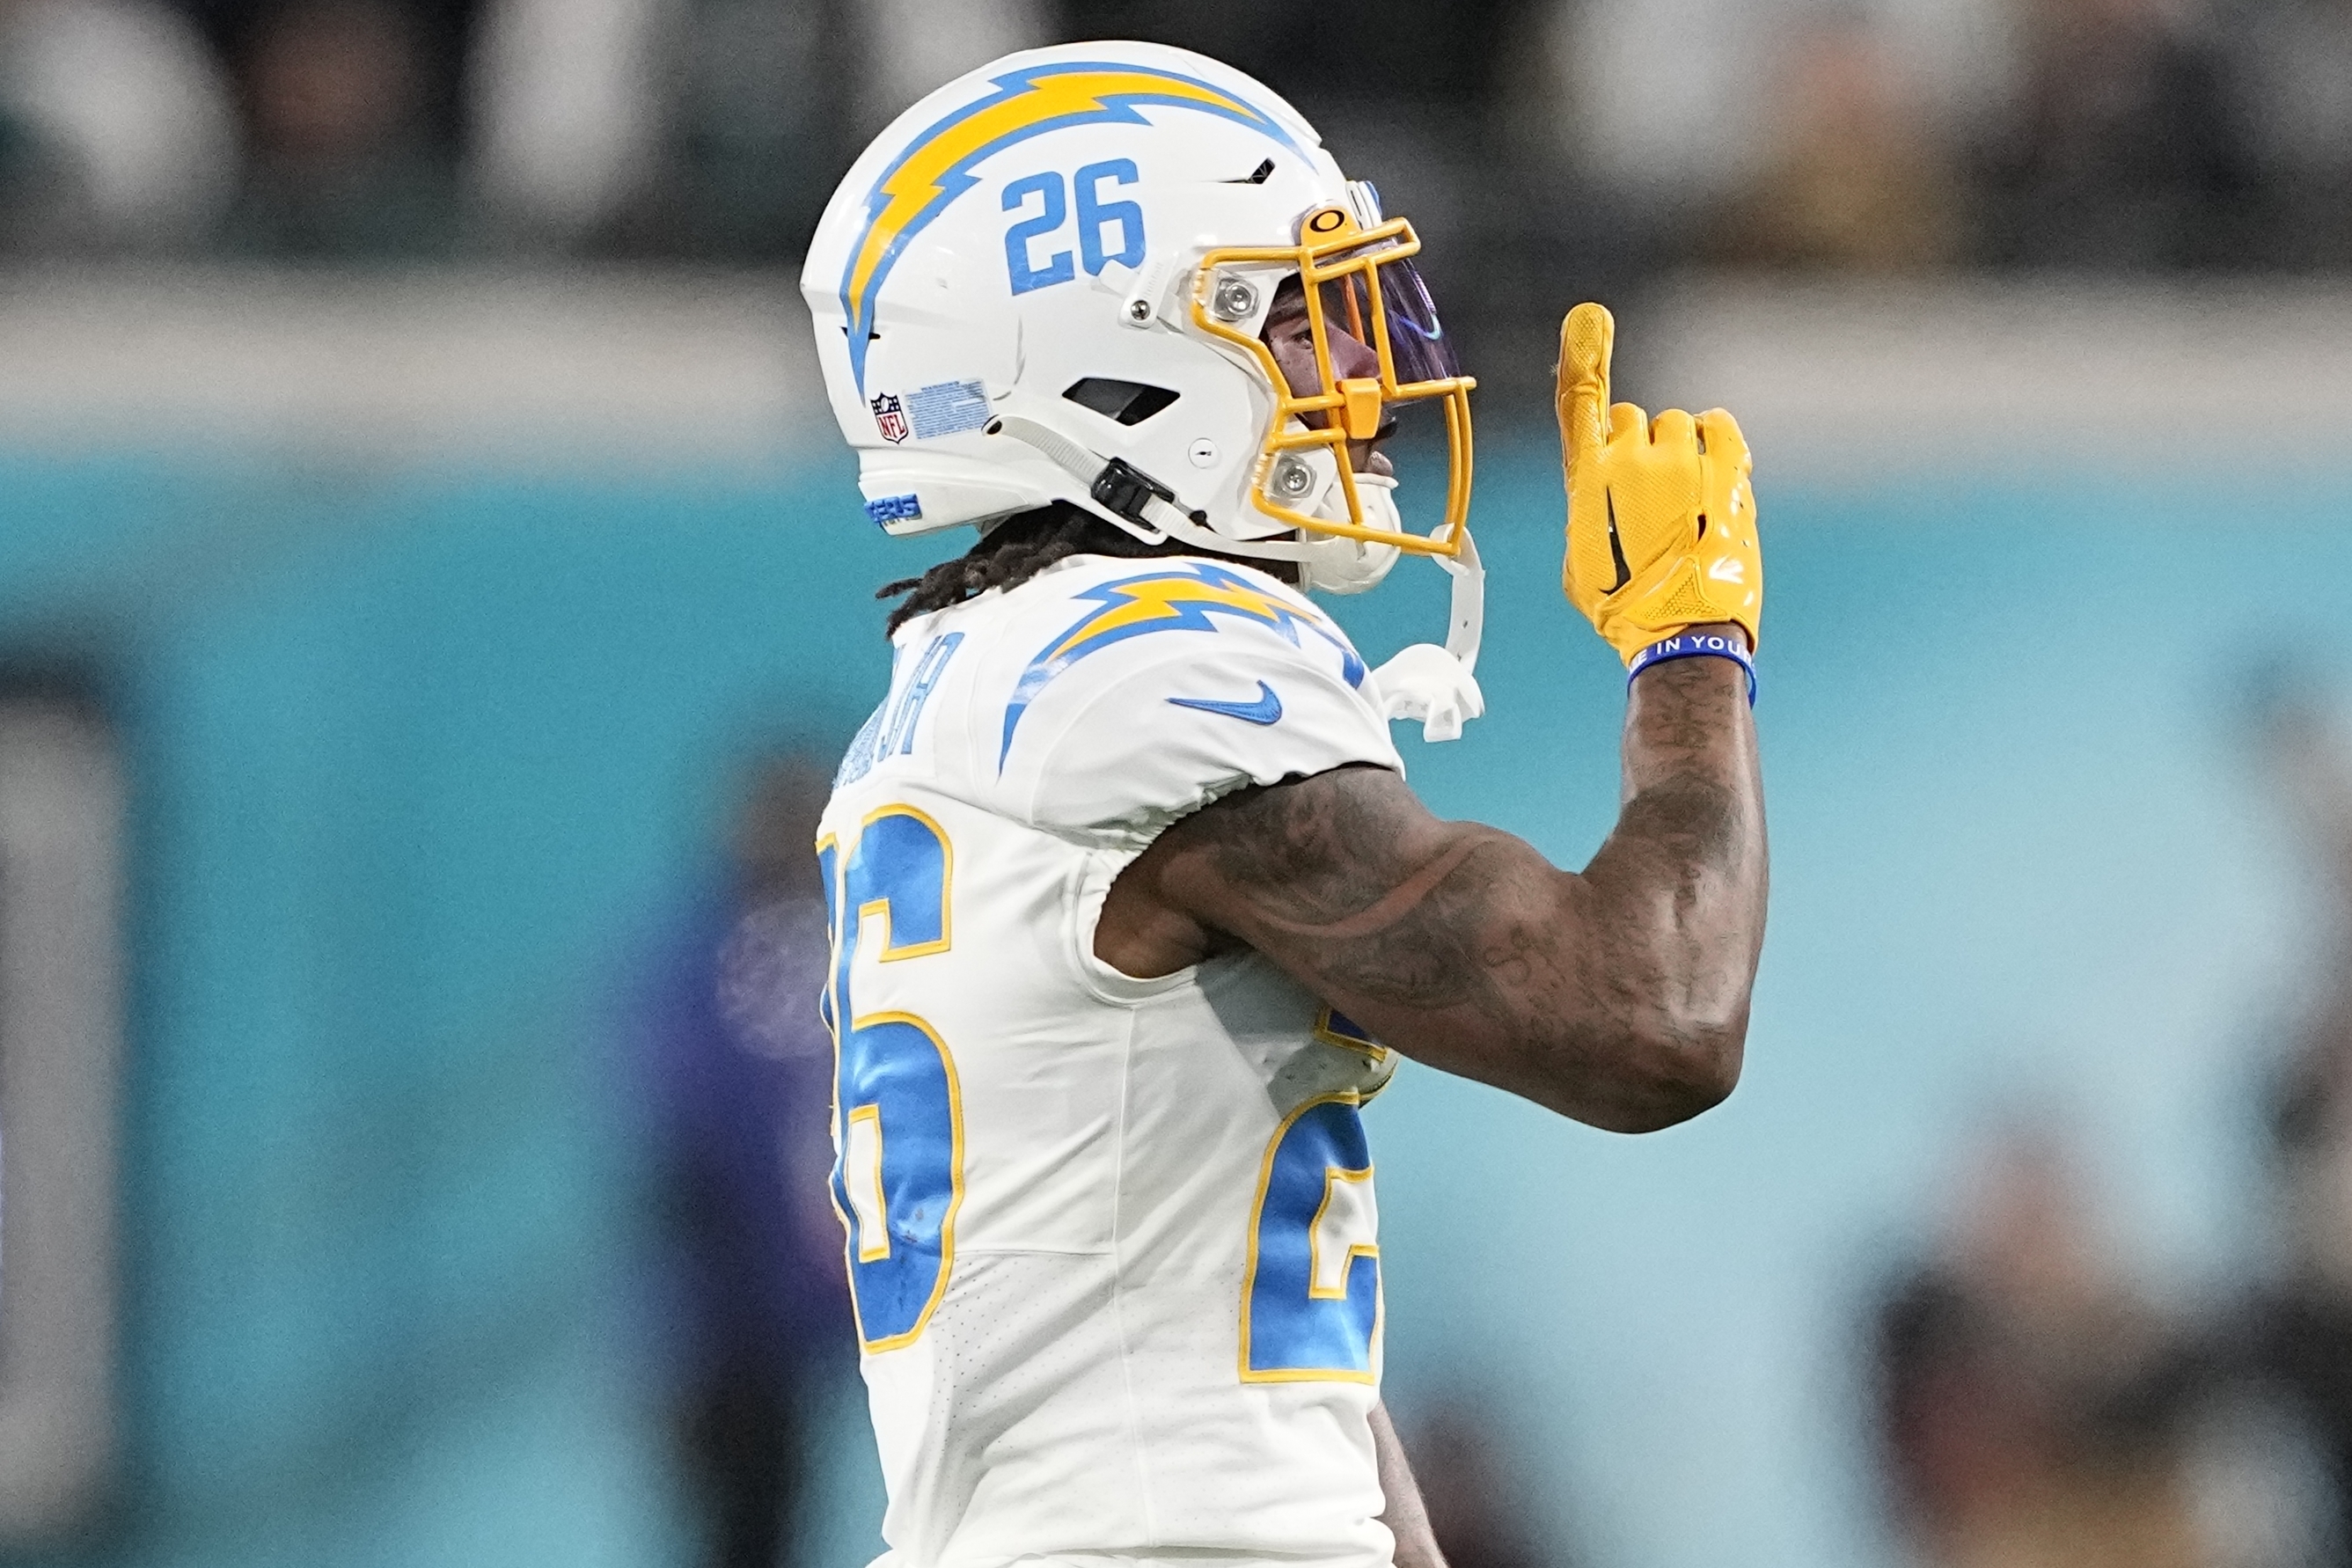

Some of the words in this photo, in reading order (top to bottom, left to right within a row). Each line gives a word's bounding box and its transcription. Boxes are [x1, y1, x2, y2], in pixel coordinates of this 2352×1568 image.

[1001, 158, 1147, 297] 26
[877, 414, 906, 439] NFL
[1657, 638, 1681, 655] IN
[816, 802, 964, 1355] 6
